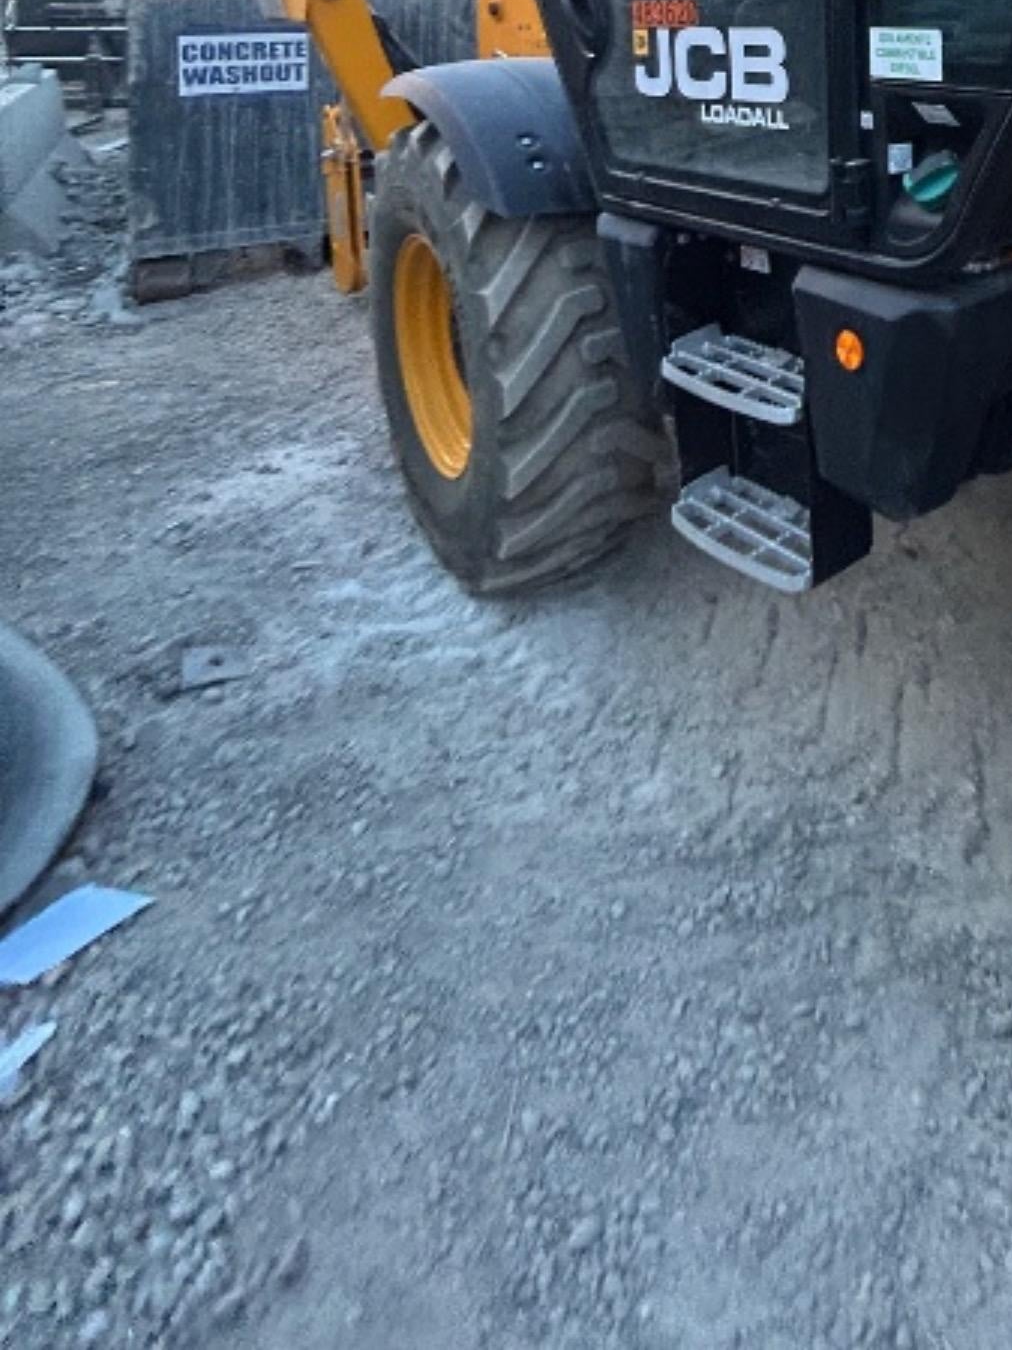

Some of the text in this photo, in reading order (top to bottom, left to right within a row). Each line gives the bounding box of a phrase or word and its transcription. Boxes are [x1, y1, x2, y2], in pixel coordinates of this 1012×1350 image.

[182, 41, 306, 62] CONCRETE
[182, 63, 305, 86] WASHOUT
[634, 26, 790, 103] JCB
[701, 103, 790, 130] LOADALL
